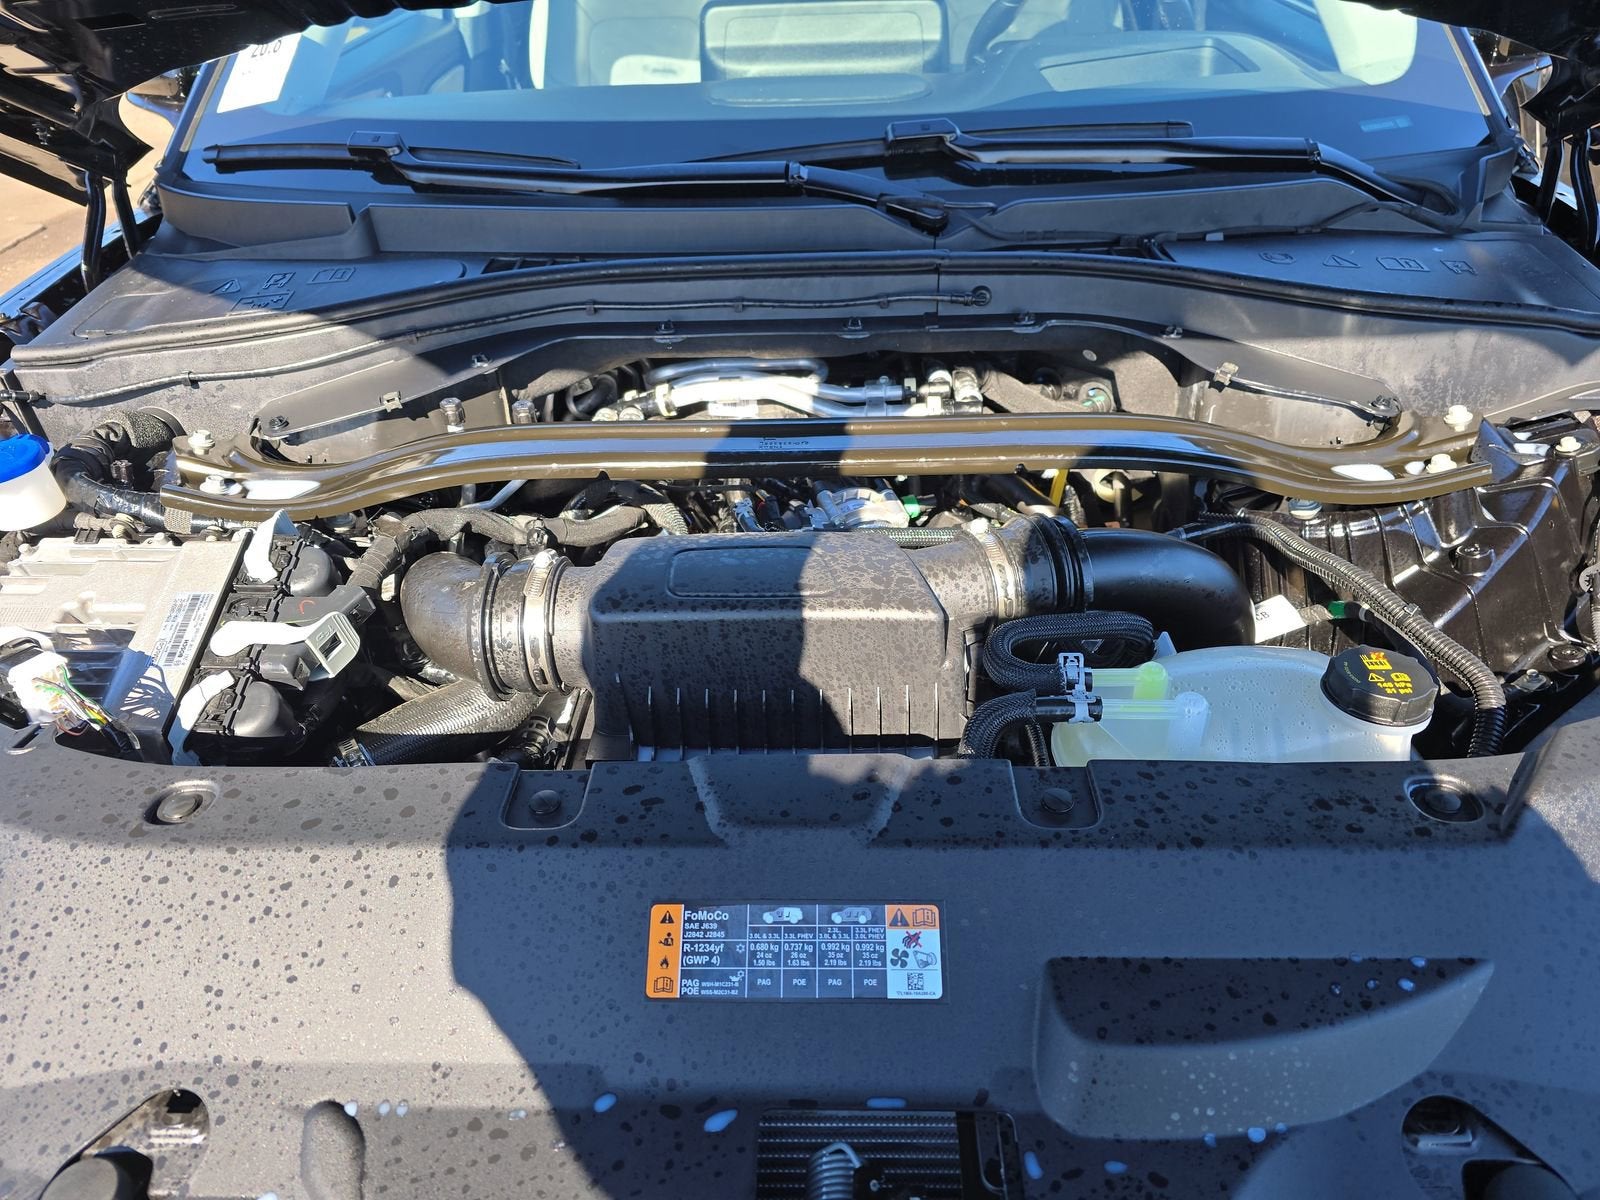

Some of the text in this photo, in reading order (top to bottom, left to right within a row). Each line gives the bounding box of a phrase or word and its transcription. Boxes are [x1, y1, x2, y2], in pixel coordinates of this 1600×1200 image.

[177, 639, 189, 658] BOSCH
[1398, 687, 1413, 695] psi
[684, 910, 729, 921] FoMoCo
[683, 943, 725, 954] R-1234yf
[750, 943, 779, 952] 0.680 kg
[784, 943, 813, 952] 0.737 kg
[820, 943, 850, 952] 0.992 kg
[855, 943, 885, 953] 0.992 kg
[756, 951, 764, 959] 24
[791, 951, 799, 959] 26
[828, 951, 836, 959] 35
[682, 955, 721, 966] (GWP 4)
[681, 979, 700, 987] PAG
[757, 978, 772, 986] PAG
[792, 978, 807, 986] POE
[828, 978, 842, 986] PAG
[863, 978, 878, 986] POE
[681, 987, 700, 995] POE
